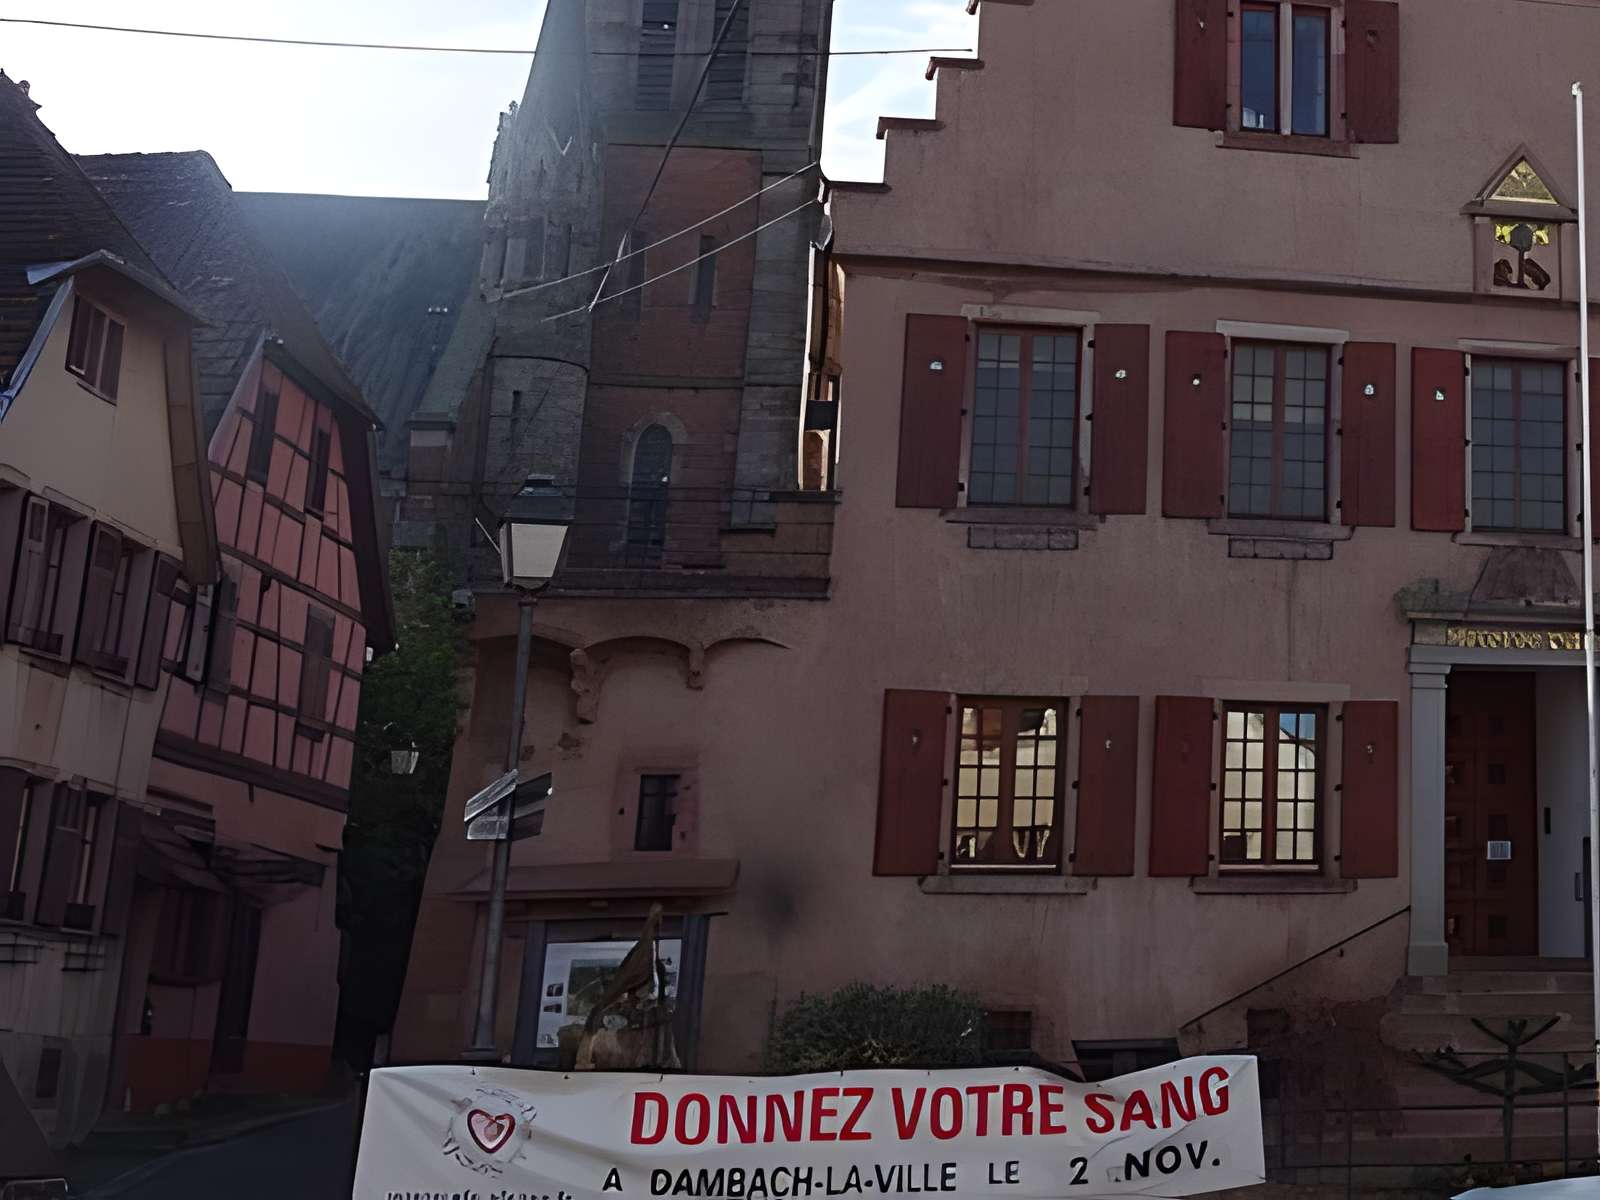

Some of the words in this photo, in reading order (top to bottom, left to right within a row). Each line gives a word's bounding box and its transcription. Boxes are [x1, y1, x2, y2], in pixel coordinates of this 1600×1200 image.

[630, 1086, 874, 1145] DONNEZ
[891, 1083, 1067, 1140] VOTRE
[1083, 1066, 1230, 1134] SANG
[602, 1167, 623, 1192] A
[650, 1162, 957, 1199] DAMBACH-LA-VILLE
[988, 1160, 1020, 1184] LE
[1069, 1156, 1089, 1185] 2
[1124, 1140, 1221, 1181] NOV.
